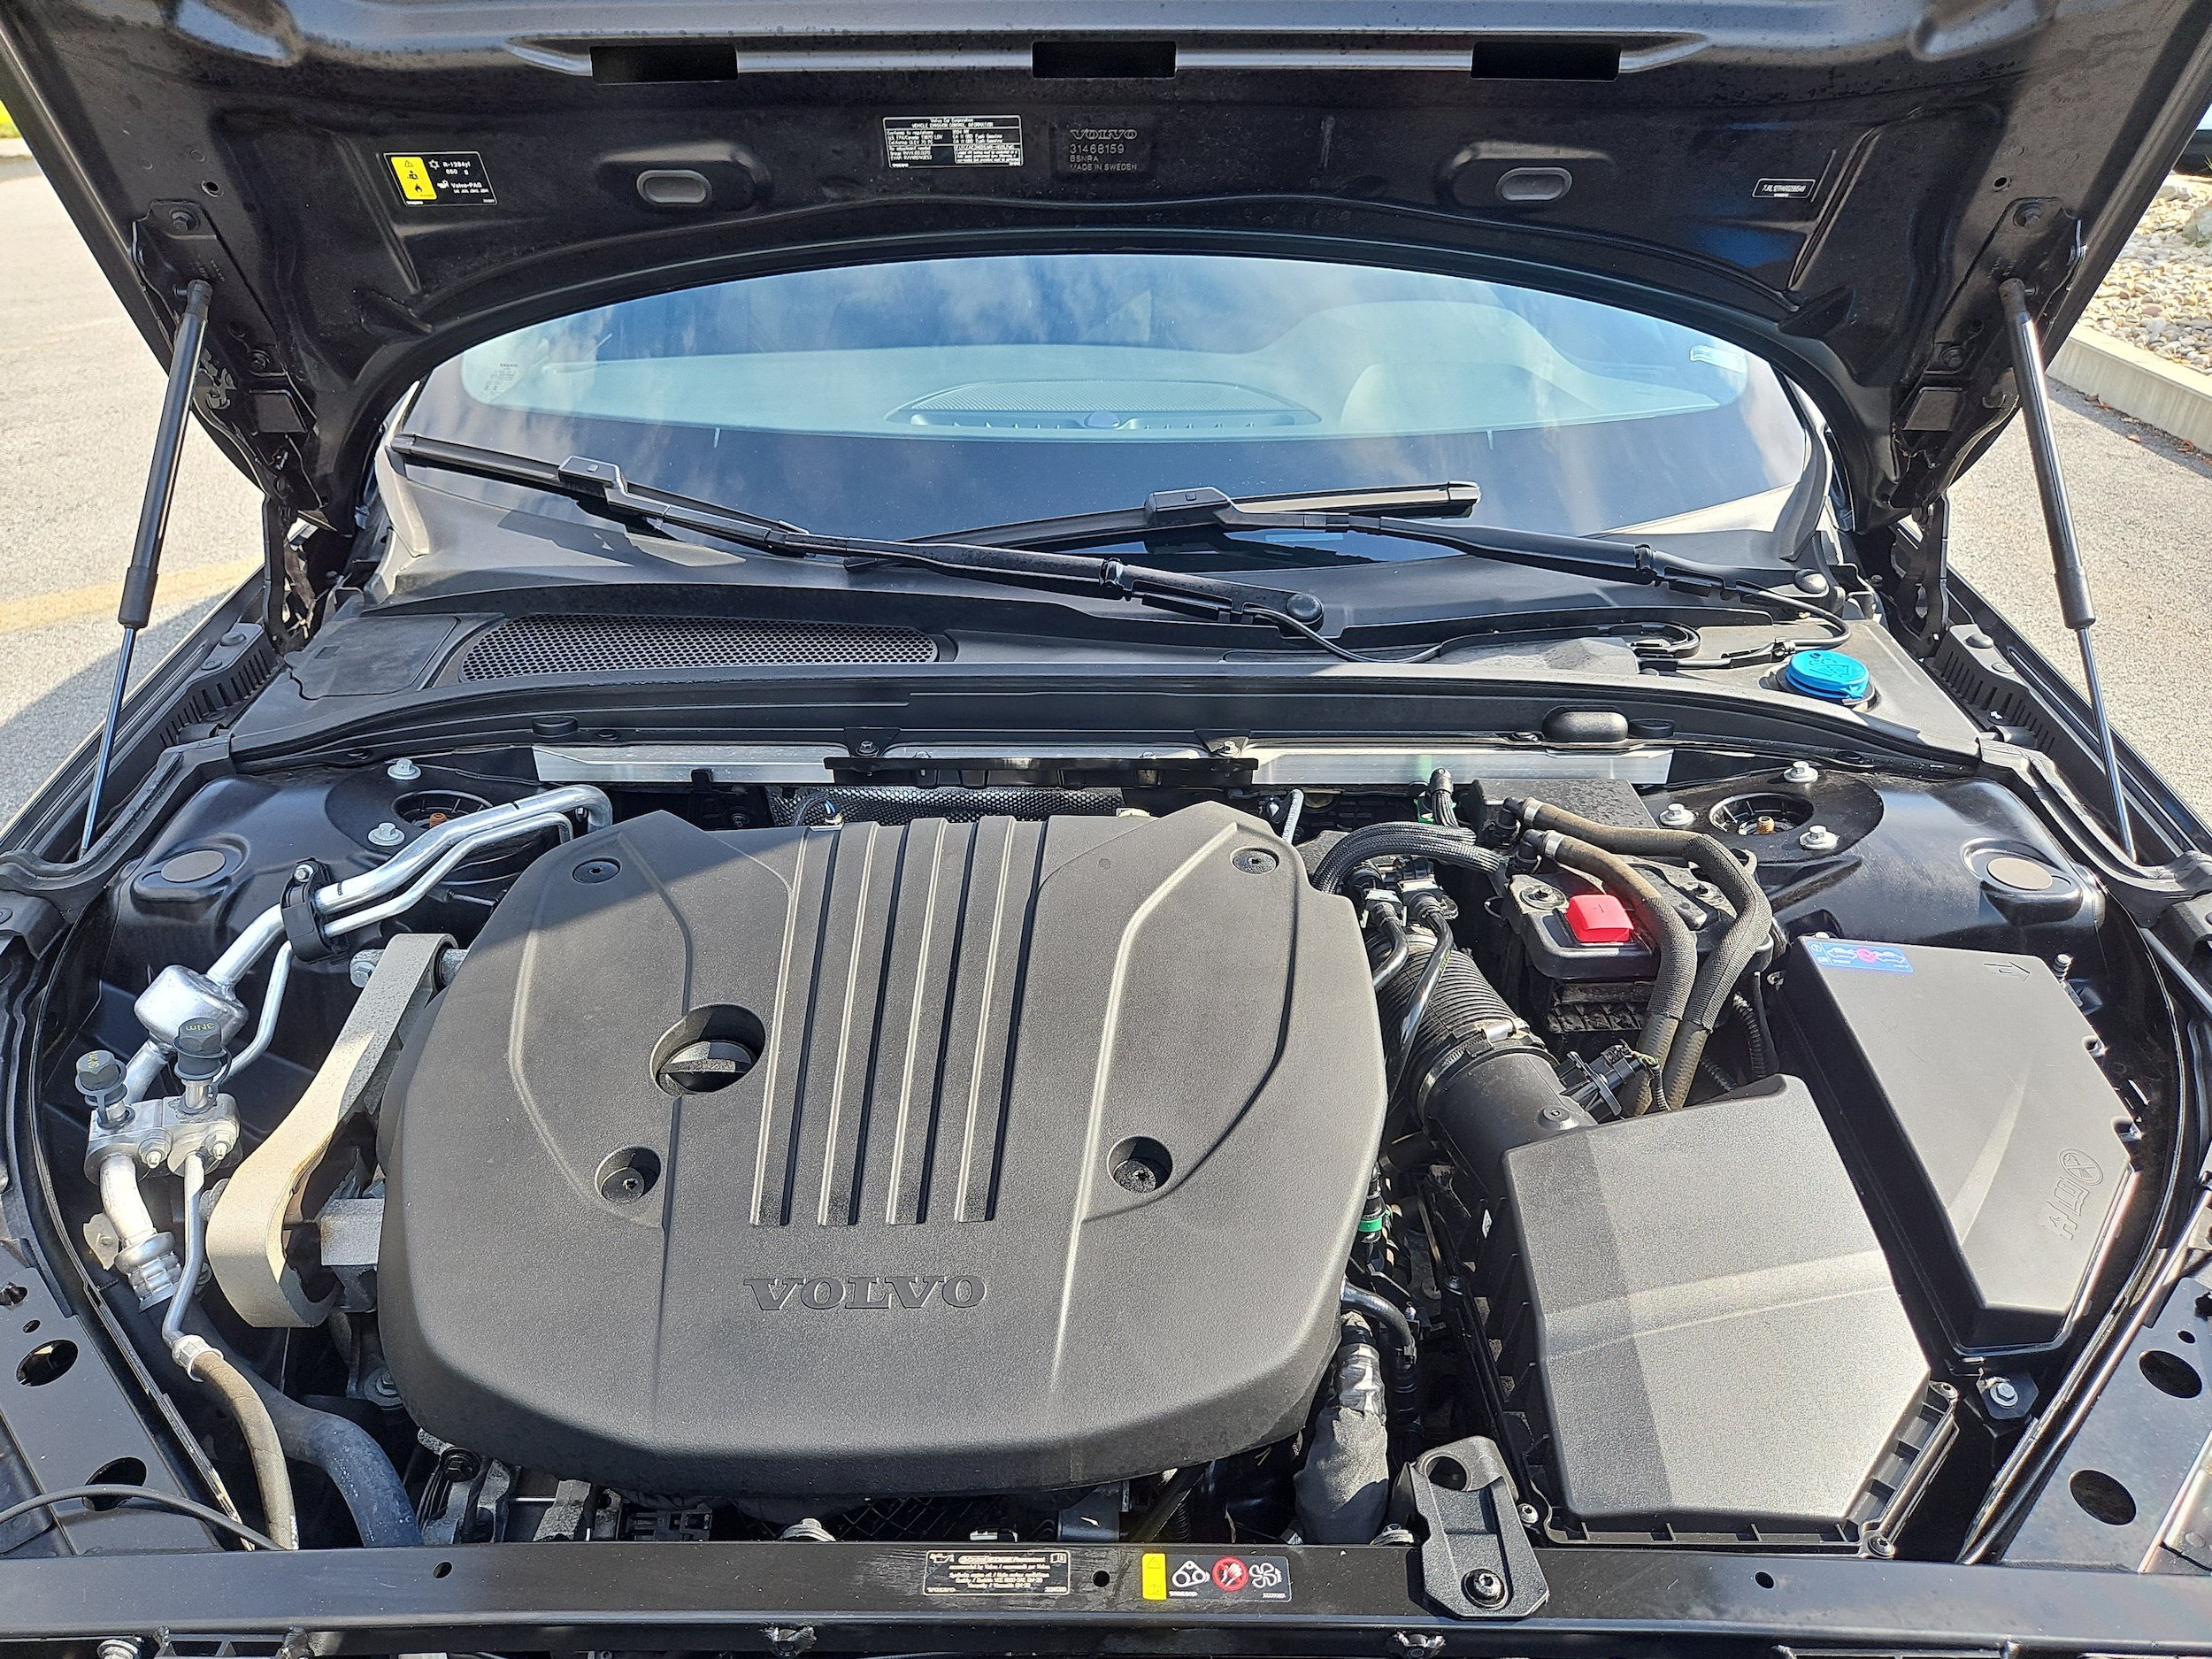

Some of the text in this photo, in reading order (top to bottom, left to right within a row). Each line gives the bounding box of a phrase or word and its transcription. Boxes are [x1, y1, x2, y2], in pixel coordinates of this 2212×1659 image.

[1070, 129, 1138, 140] VOLVO
[1070, 143, 1125, 155] 31468159
[185, 1022, 215, 1032] 3Nm
[742, 1275, 987, 1311] VOLVO
